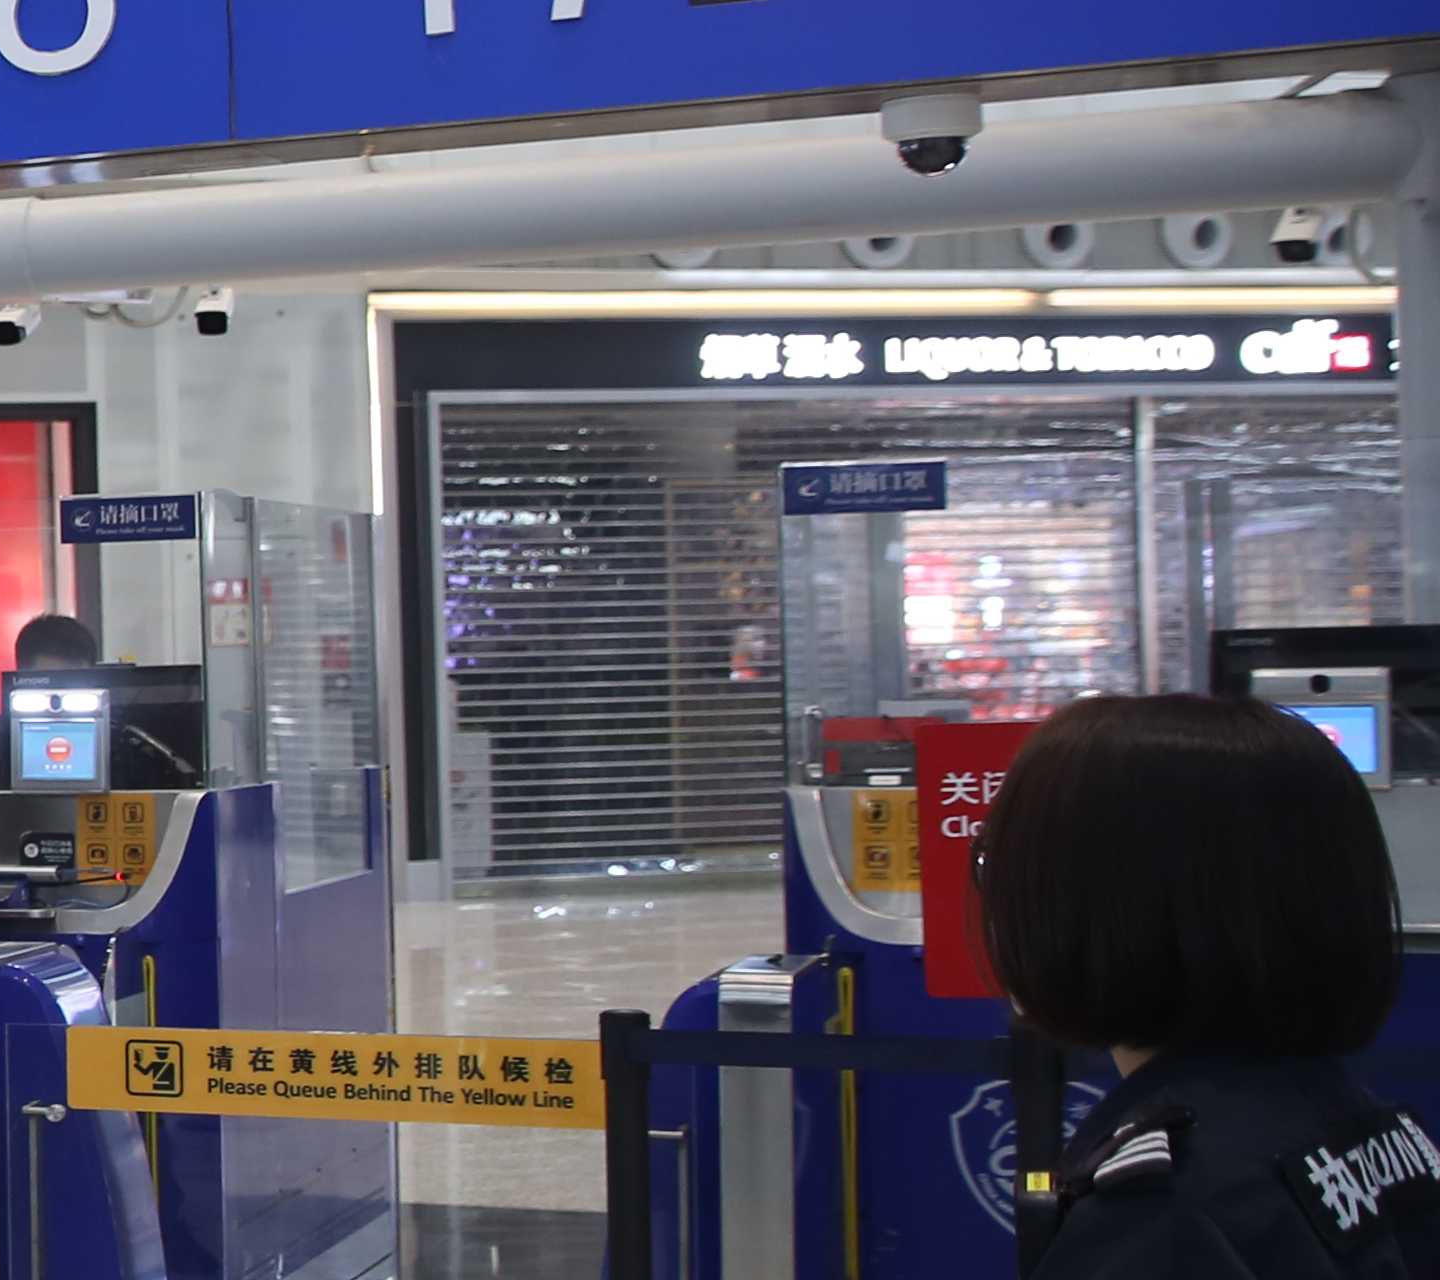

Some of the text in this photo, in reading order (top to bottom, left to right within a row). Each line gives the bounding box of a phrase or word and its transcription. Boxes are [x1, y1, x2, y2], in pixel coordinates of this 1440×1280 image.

[13, 676, 50, 686] Lenovo
[941, 815, 984, 839] Clo
[207, 1045, 574, 1085] 请在黄线外排队候检
[207, 1077, 575, 1110] Please Queue Behind The Yellow Line
